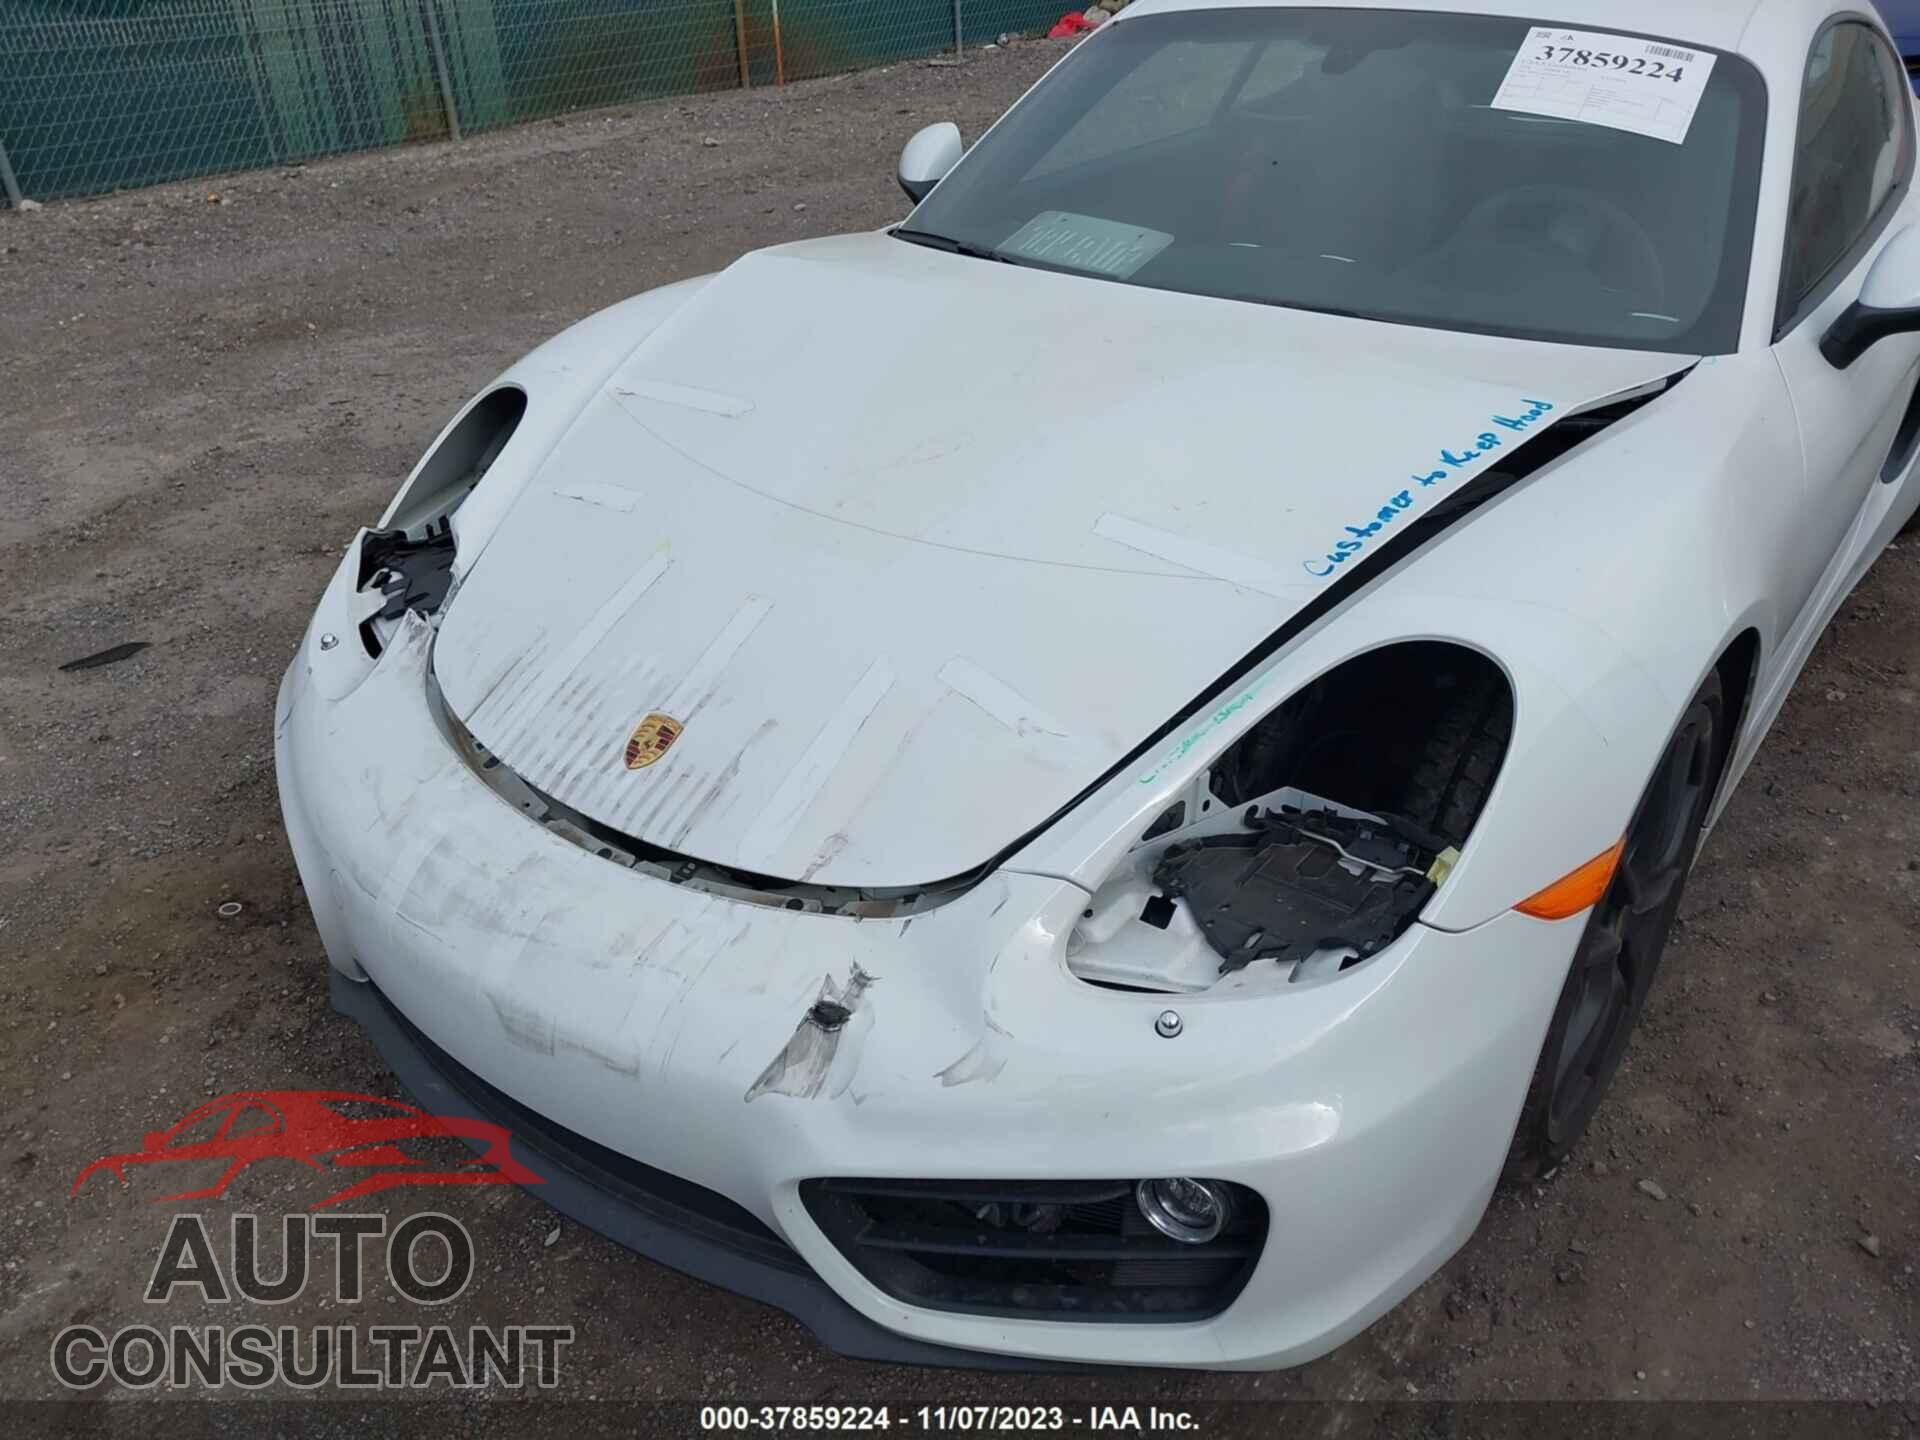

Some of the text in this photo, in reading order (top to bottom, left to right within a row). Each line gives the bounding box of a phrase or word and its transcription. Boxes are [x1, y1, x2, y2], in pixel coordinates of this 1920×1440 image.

[1535, 45, 1684, 83] 37859224
[1303, 489, 1413, 576] Customer
[1411, 469, 1447, 487] to
[1491, 398, 1554, 431] Hood
